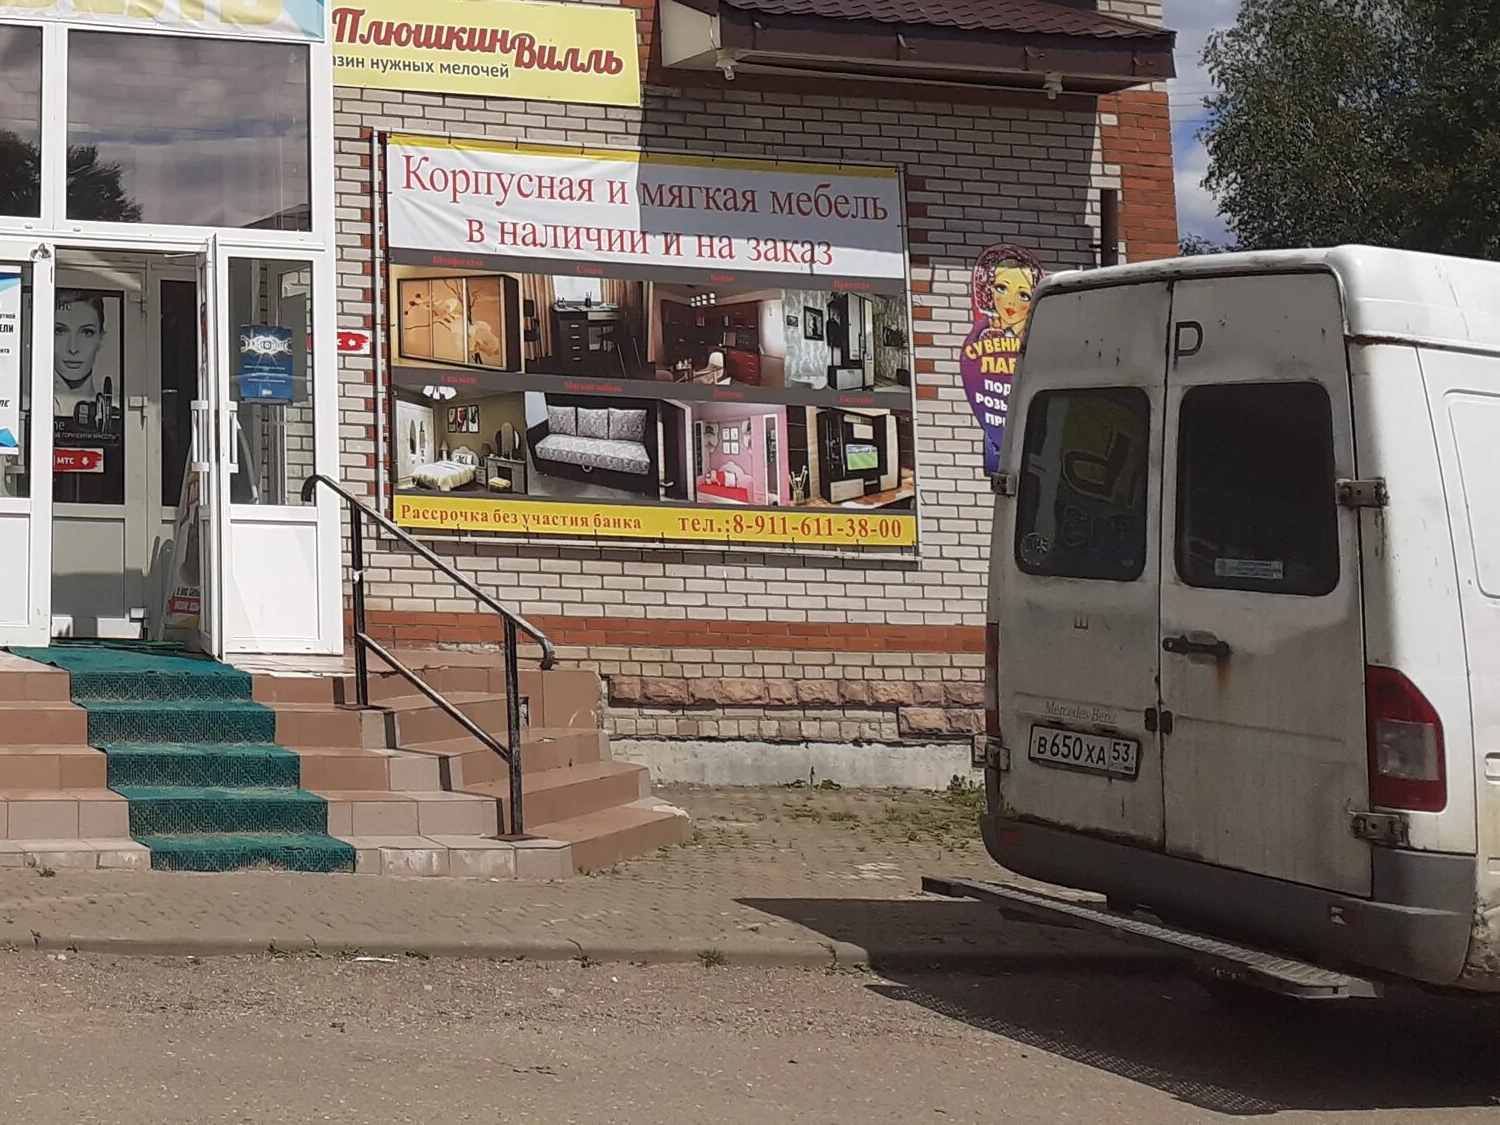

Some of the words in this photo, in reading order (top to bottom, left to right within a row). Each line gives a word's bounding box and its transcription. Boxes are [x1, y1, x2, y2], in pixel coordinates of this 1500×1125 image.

[371, 57, 434, 73] нужных
[440, 63, 509, 78] мелочей
[402, 155, 594, 206] Корпусная
[606, 180, 628, 205] и
[640, 182, 758, 213] мягкая
[770, 183, 888, 220] мебель
[466, 219, 485, 243] в
[498, 220, 650, 254] наличии
[661, 232, 683, 257] и
[696, 234, 736, 260] на
[747, 236, 833, 265] заказ
[965, 337, 1021, 360] СУВЕНИ
[57, 457, 74, 465] МТС
[400, 504, 488, 524] Рассрочка
[493, 509, 518, 523] без
[522, 513, 589, 528] участия
[594, 514, 642, 529] банка
[1112, 741, 1131, 762] 53
